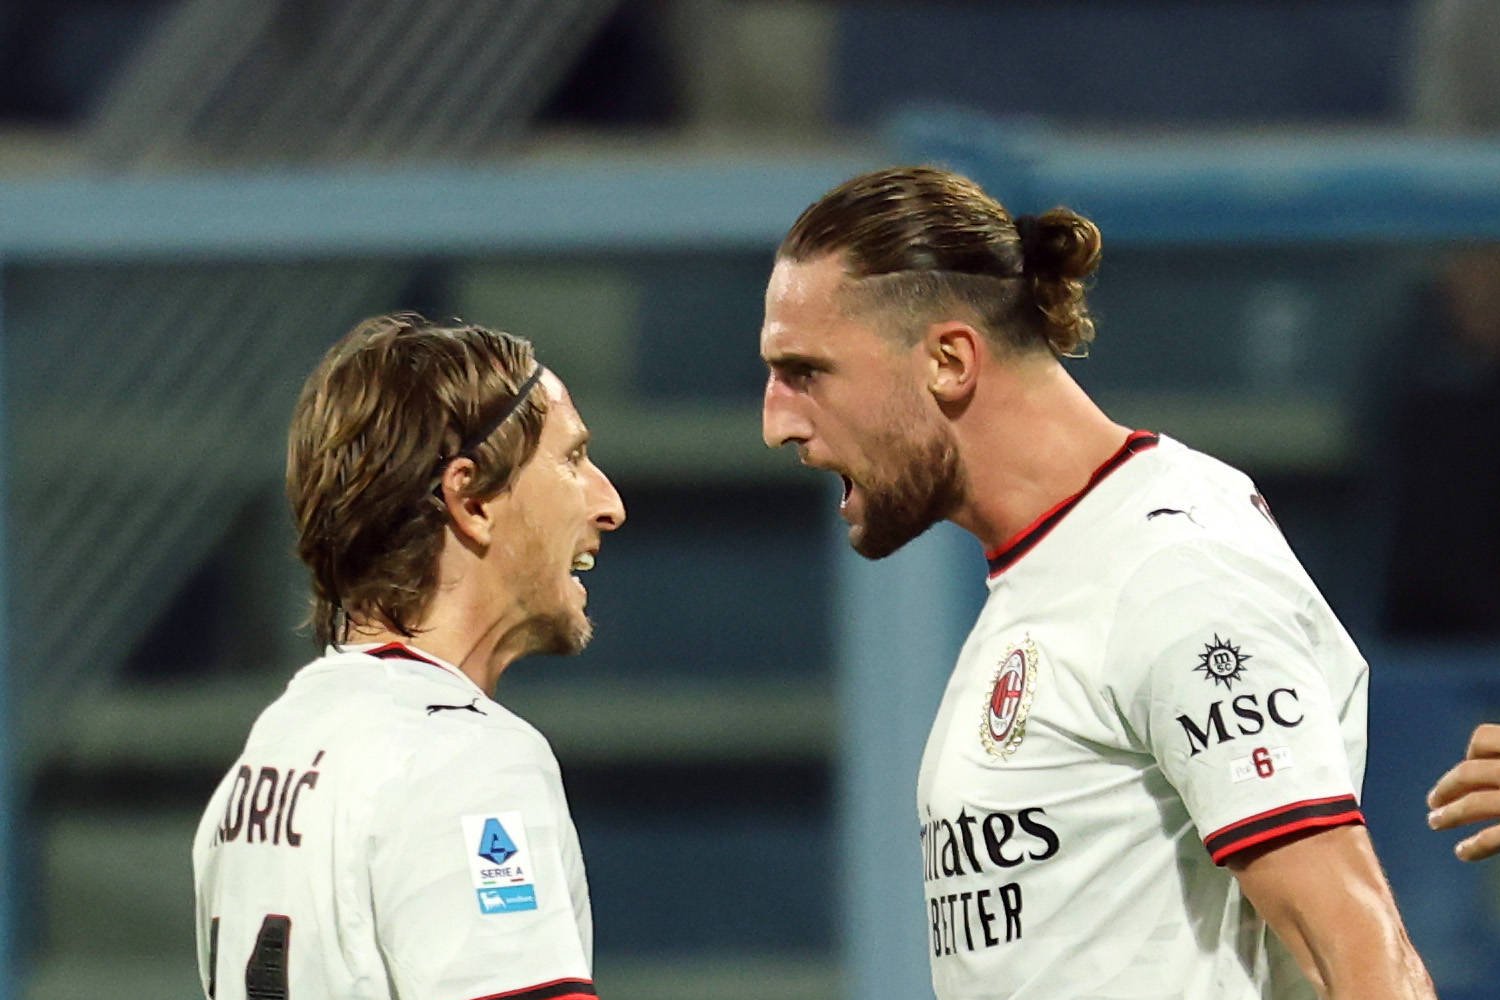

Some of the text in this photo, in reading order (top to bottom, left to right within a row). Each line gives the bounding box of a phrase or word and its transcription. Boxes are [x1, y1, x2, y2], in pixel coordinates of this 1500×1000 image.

[1176, 688, 1305, 757] MSC
[1252, 747, 1275, 779] 6
[209, 750, 326, 847] DRIĆ
[480, 866, 524, 879] SERIE A
[930, 882, 1022, 958] BETTER
